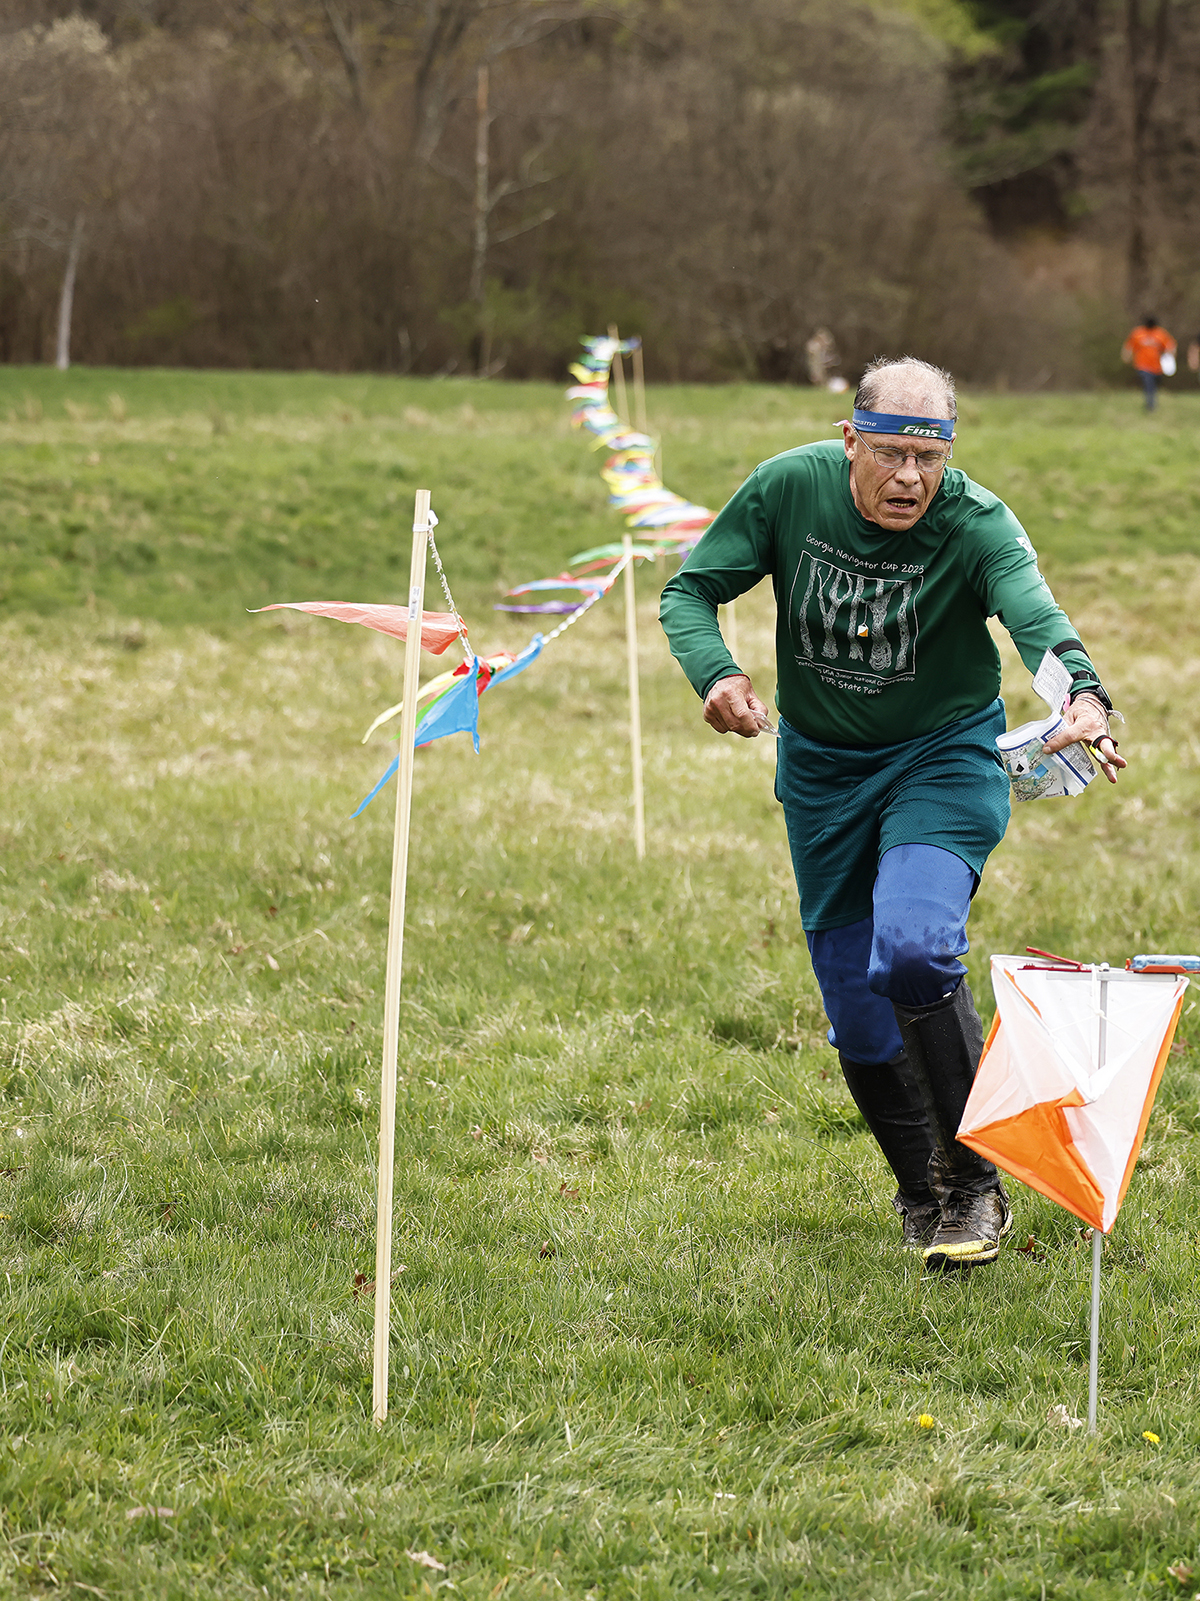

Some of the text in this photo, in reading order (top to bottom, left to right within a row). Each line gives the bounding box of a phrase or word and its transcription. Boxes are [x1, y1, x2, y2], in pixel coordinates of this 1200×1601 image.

[805, 533, 924, 575] Georgia Navigator Cup 2023
[838, 680, 861, 692] State
[863, 686, 883, 695] Park
